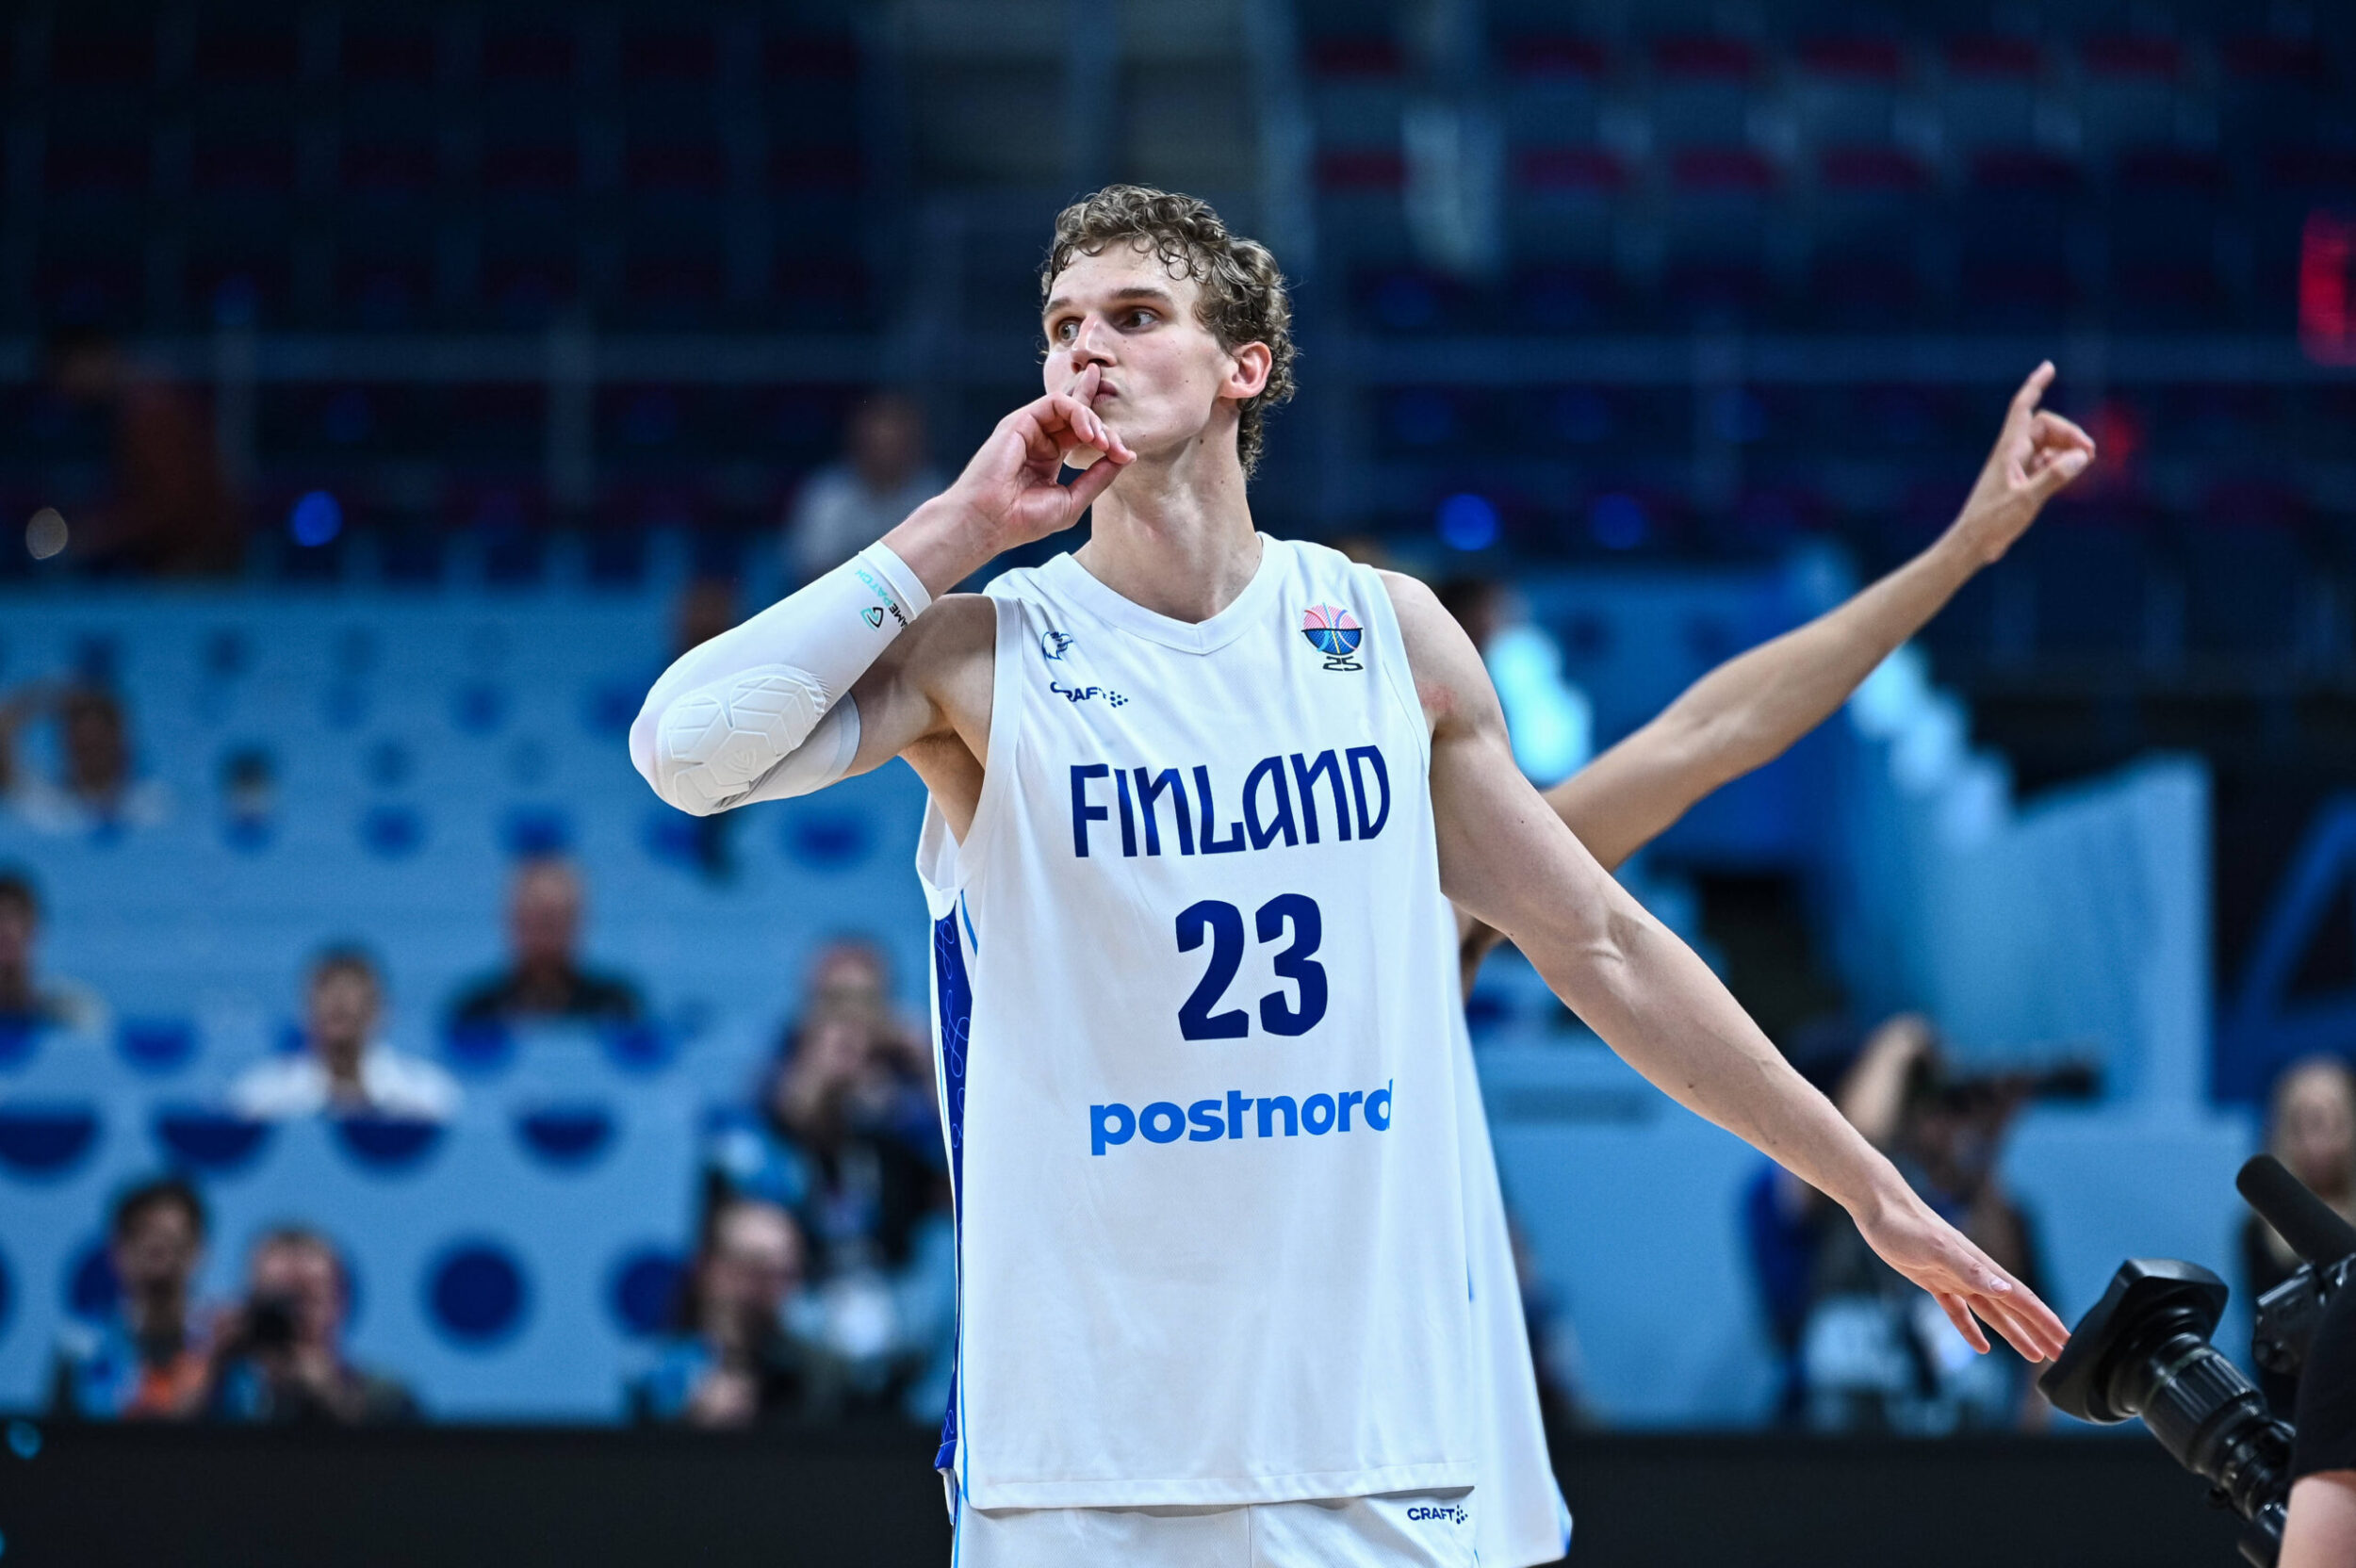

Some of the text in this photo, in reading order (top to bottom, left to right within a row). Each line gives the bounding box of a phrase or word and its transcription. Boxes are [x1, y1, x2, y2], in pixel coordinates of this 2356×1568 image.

[854, 569, 908, 630] AMEPATCH
[1175, 893, 1328, 1040] 23
[1089, 1078, 1393, 1156] postnord
[1407, 1508, 1455, 1521] CRAFT
